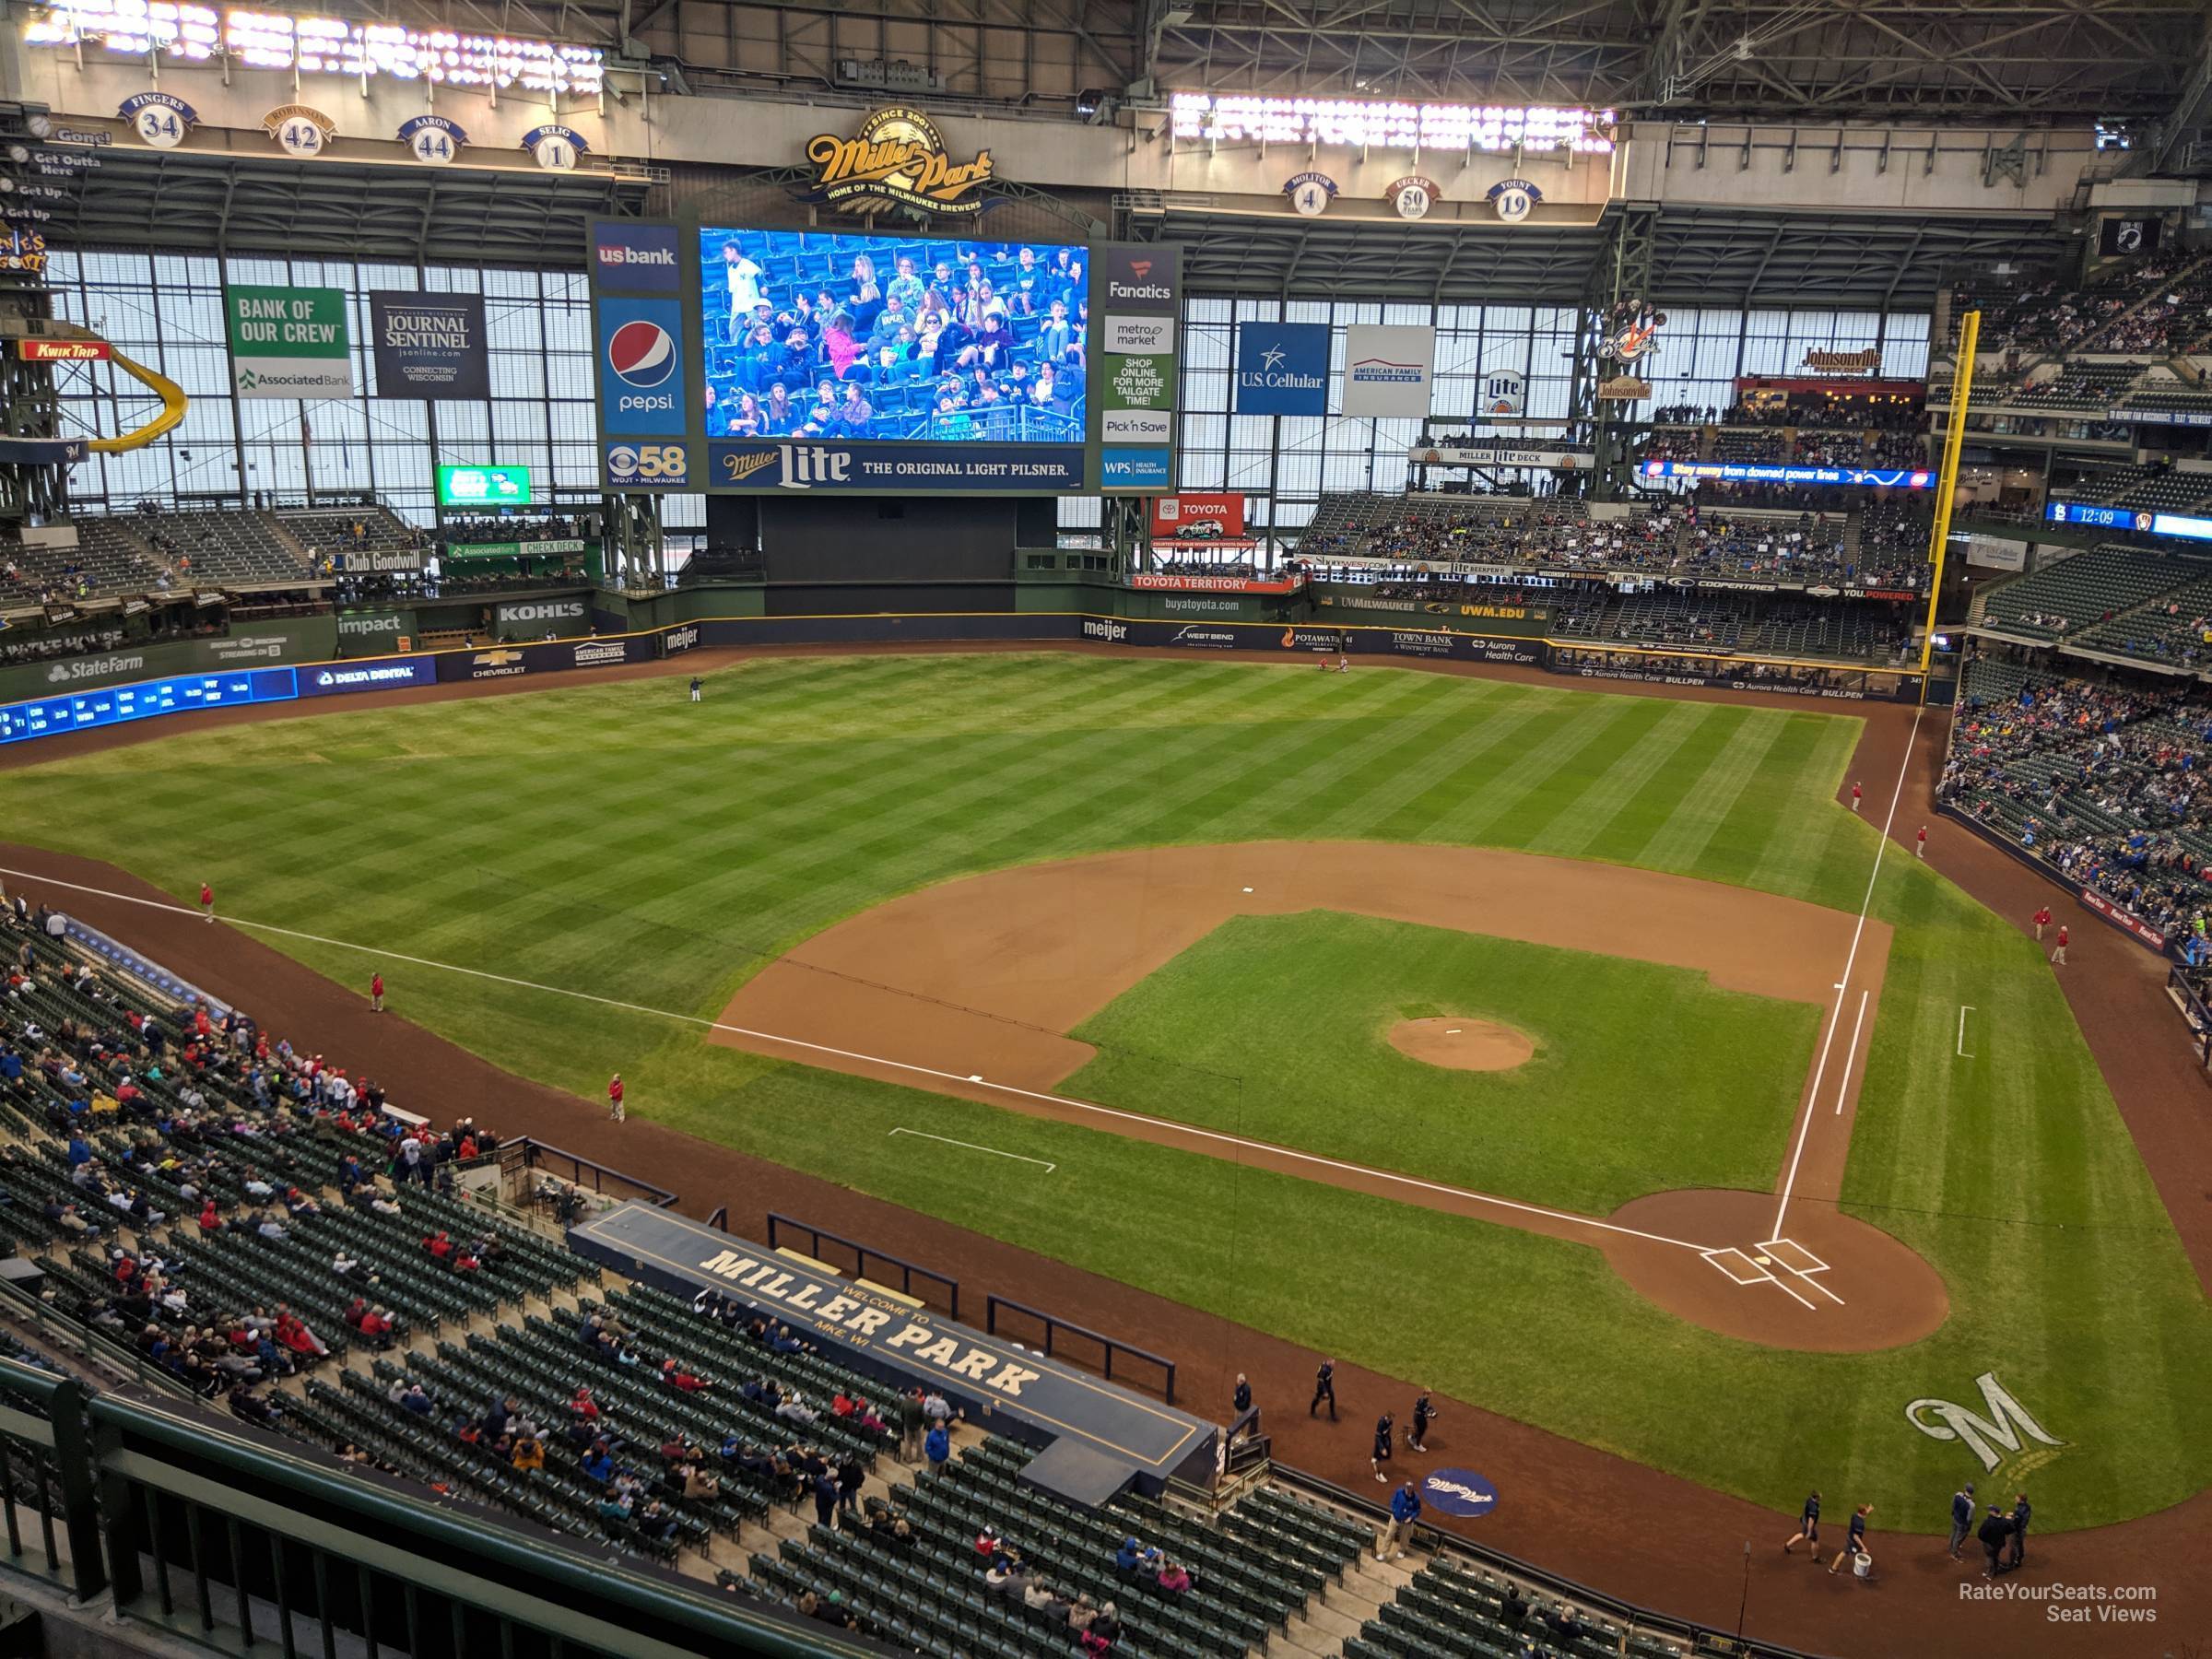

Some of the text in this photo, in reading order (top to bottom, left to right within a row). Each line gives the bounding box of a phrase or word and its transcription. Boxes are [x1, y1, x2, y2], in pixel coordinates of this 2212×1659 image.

[131, 94, 185, 112] FINGERS
[271, 105, 325, 124] ROBINSON
[871, 109, 929, 129] SINCE 2001
[142, 112, 178, 138] 34
[415, 117, 452, 130] AARON
[57, 129, 112, 145] Gone!
[284, 125, 319, 149] 42
[538, 126, 571, 137] SELIG
[418, 135, 450, 159] 44
[34, 153, 101, 168] Get Outta
[551, 147, 564, 167] 1
[808, 135, 993, 193] Miller Park
[41, 165, 74, 176] Here
[1292, 174, 1331, 187] MOLITOR
[1396, 177, 1430, 189] UECKER
[1500, 181, 1531, 190] YOUNT
[18, 185, 63, 199] Get Up
[828, 184, 982, 213] HOME OF THE MILWAUKEE BREWERS
[1303, 191, 1315, 206] 4
[1403, 190, 1423, 206] 50
[1502, 195, 1526, 215] 19
[6, 207, 51, 221] Get Up
[1110, 282, 1171, 300] Fanatics
[238, 299, 314, 320] BANK OF
[385, 315, 470, 333] JOURNAL
[1118, 324, 1151, 335] metro
[241, 323, 278, 342] OUR
[386, 332, 470, 348] SENTINEL
[1118, 335, 1156, 346] market
[399, 348, 461, 358] jsonline.com
[1802, 347, 1882, 367] Johnsonville
[403, 366, 457, 374] CONNECTING
[1125, 359, 1153, 368] SHOP
[1121, 368, 1157, 378] ONLINE
[1354, 367, 1422, 376] AMERICAN FAMILY
[1113, 377, 1164, 387] FOR MORE
[1241, 372, 1324, 389] U.S. Cellular
[1116, 387, 1160, 396] TAILGATE
[1488, 379, 1519, 398] Lite
[1600, 384, 1650, 397] Johnsonville
[619, 394, 673, 412] pepsi
[1125, 396, 1150, 406] TIME!
[1107, 421, 1129, 432] Pick
[1140, 422, 1167, 432] Save
[638, 446, 687, 477] 58
[1459, 451, 1491, 460] MILLER
[723, 444, 1069, 488] Miller Lite THE ORIGINAL LIGHT PILSNER.
[1104, 462, 1131, 474] WPS
[1673, 464, 1840, 481] Stay away from downed power lines
[1183, 504, 1228, 514] TOYOTA
[2080, 509, 2114, 524] 12:09
[526, 540, 579, 553] CHECK DECK
[345, 550, 420, 571] Club Goodwill
[1136, 576, 1248, 590] TOYOTA TERRITORY
[1165, 597, 1240, 612] buyatoyota.com
[1461, 605, 1525, 619] UWM.EDU
[500, 603, 584, 622] KOHL'S
[338, 615, 401, 635] impact
[1084, 619, 1127, 641] meijer
[667, 627, 698, 650] meijer
[1393, 632, 1453, 645] TOWN BANK
[1487, 641, 1516, 651] Aurora
[575, 647, 604, 655] AMERICAN
[1400, 644, 1430, 653] WINTRUST
[1485, 650, 1535, 663] Health Care
[335, 666, 413, 684] DELTA DENTAL
[473, 665, 525, 678] CHEVROLET
[1594, 671, 1705, 686] Aurora Health Care BULLPEN
[1747, 682, 1864, 699] Aurora Health Care BULLPEN
[841, 1286, 930, 1325] WELCOME TO
[699, 1249, 1041, 1396] MILLER PARK
[814, 1320, 870, 1347] MKE, WI
[1427, 1477, 1493, 1503] Miller Park
